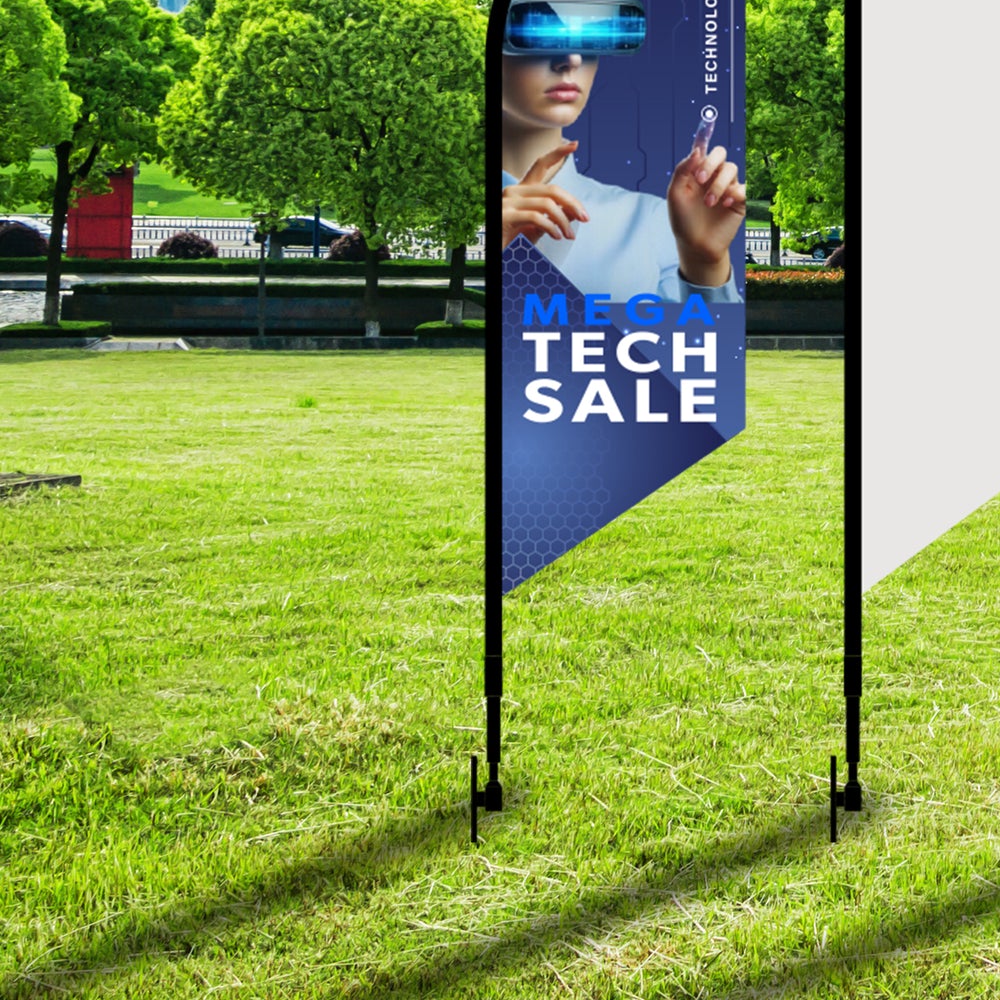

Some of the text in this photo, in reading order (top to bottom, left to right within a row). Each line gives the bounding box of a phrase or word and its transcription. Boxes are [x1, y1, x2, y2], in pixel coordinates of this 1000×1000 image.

[522, 293, 715, 326] MEGA
[522, 331, 717, 373] TECH
[522, 378, 717, 423] SALE
